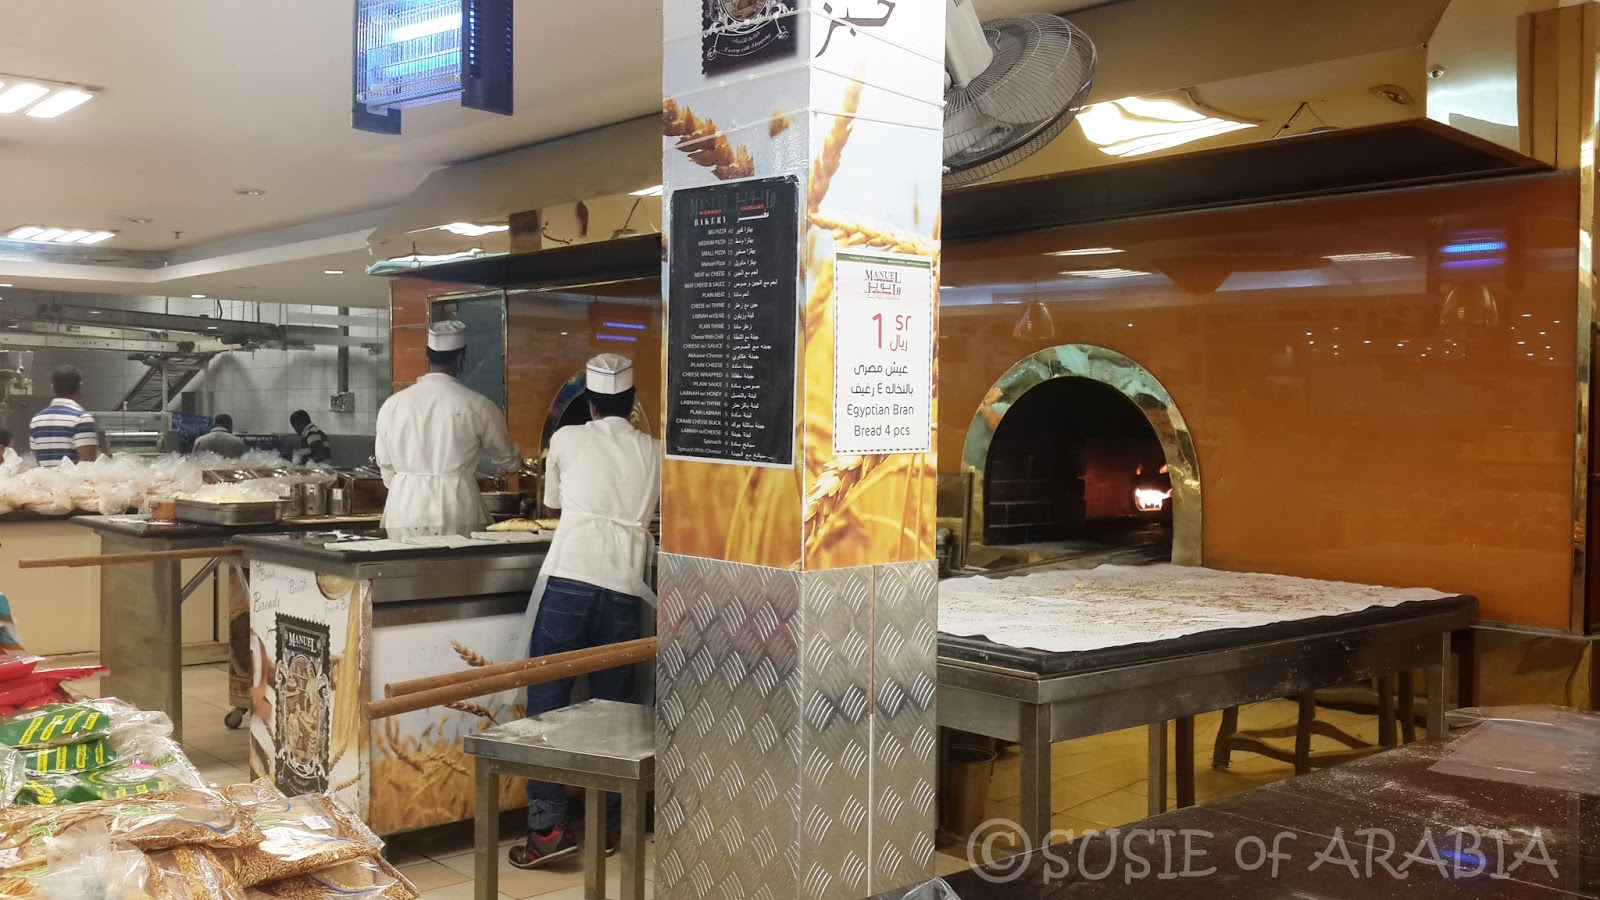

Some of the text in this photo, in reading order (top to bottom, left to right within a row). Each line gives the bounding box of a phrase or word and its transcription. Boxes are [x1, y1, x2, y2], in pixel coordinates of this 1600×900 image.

[694, 216, 726, 226] BAKERY
[865, 269, 902, 284] MANUEL
[872, 313, 882, 349] 1
[890, 334, 908, 351] ريال
[885, 360, 908, 376] عيش
[850, 382, 875, 397] رغيف
[846, 403, 914, 418] Egyptian Bran
[854, 424, 911, 438] Bread 4 pcs
[288, 631, 318, 653] MANUEL
